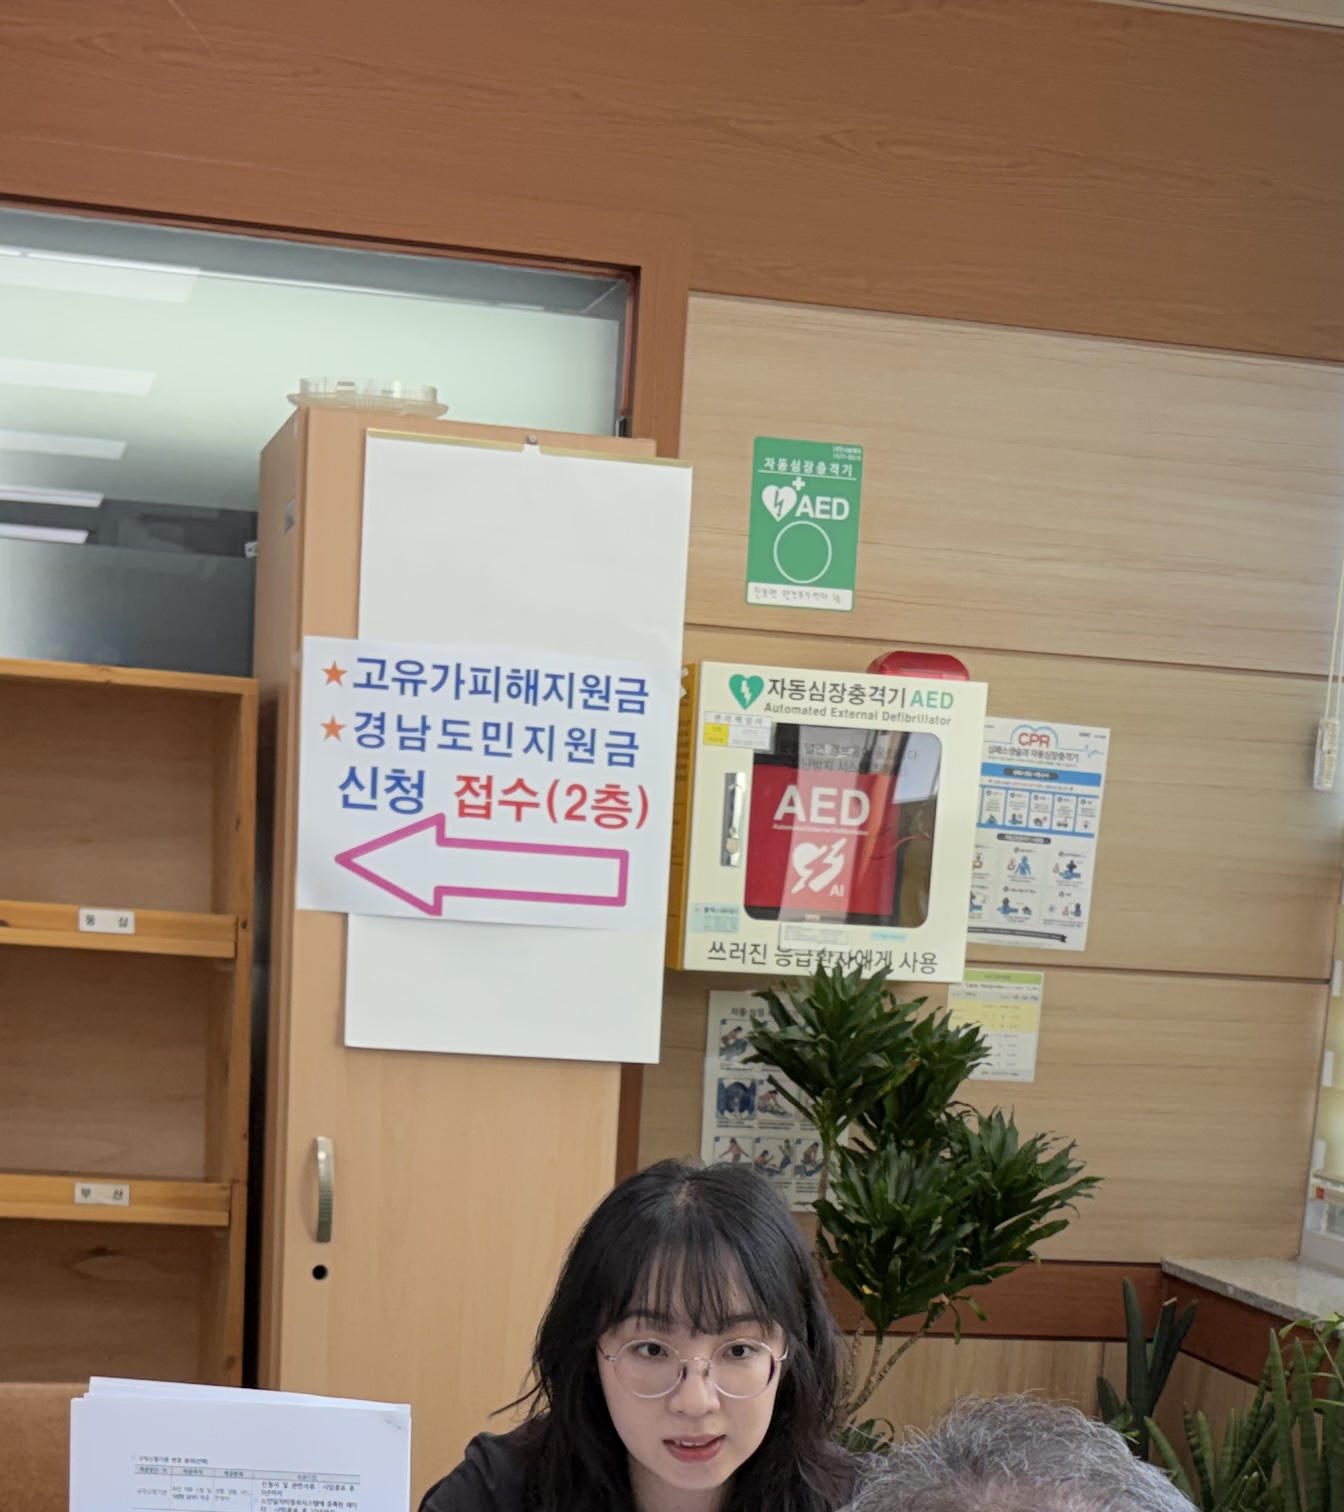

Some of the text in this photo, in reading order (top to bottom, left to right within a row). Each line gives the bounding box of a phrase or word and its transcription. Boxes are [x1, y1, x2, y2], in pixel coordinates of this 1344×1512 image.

[764, 457, 854, 478] 자동심장충격기
[794, 495, 850, 521] AED
[353, 657, 649, 714] 고유가피해지원금
[767, 678, 954, 710] 자동심장충격기 AED
[764, 702, 952, 726] Automated External Defibrillator
[353, 711, 640, 768] 경남도민지원금
[1018, 732, 1051, 748] CPR
[339, 766, 649, 831] 신청 접수(2층)
[773, 784, 870, 826] AED
[829, 884, 845, 897] AI
[707, 941, 767, 966] 쓰러진
[899, 951, 939, 974] 사용
